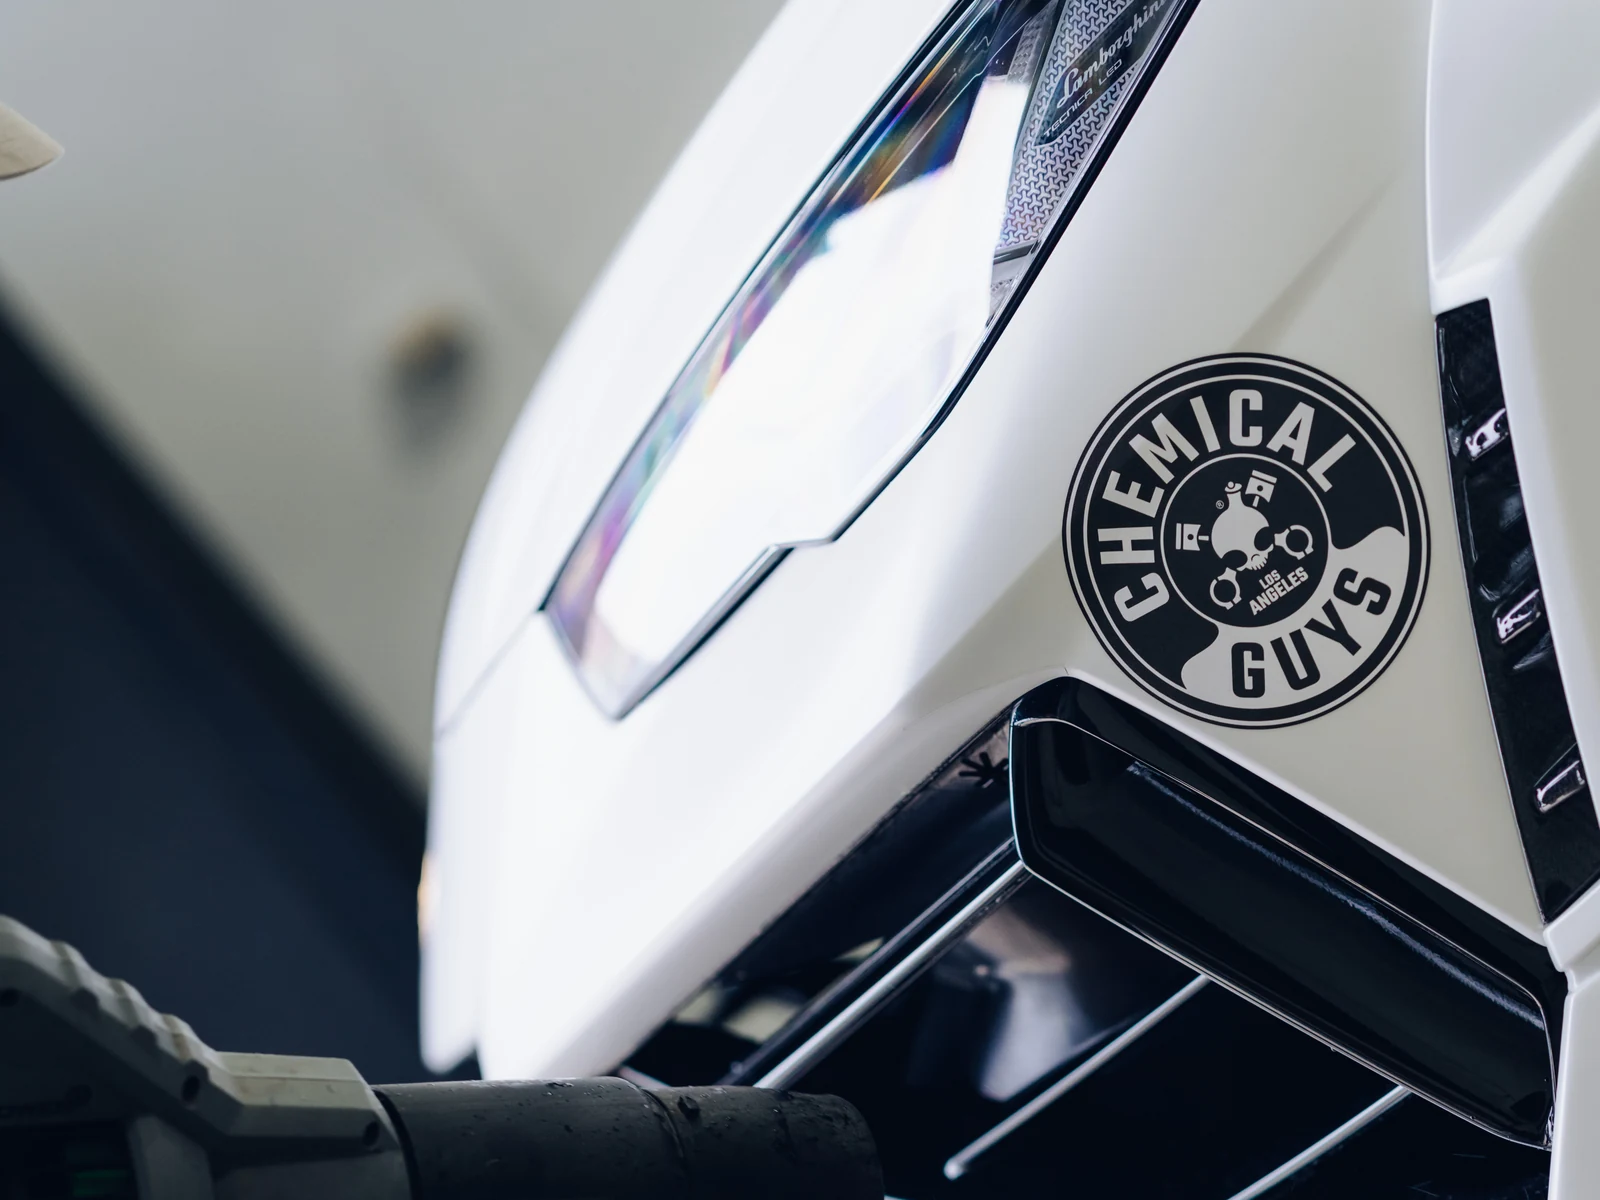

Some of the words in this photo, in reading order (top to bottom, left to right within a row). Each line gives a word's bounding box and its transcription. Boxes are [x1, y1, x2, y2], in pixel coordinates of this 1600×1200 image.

[1043, 88, 1093, 137] TECNICA
[1098, 59, 1122, 85] LED
[1098, 389, 1356, 622] CHEMICAL
[1249, 566, 1309, 615] ANGELES
[1259, 569, 1281, 590] LOS
[1231, 567, 1391, 698] GUYS
